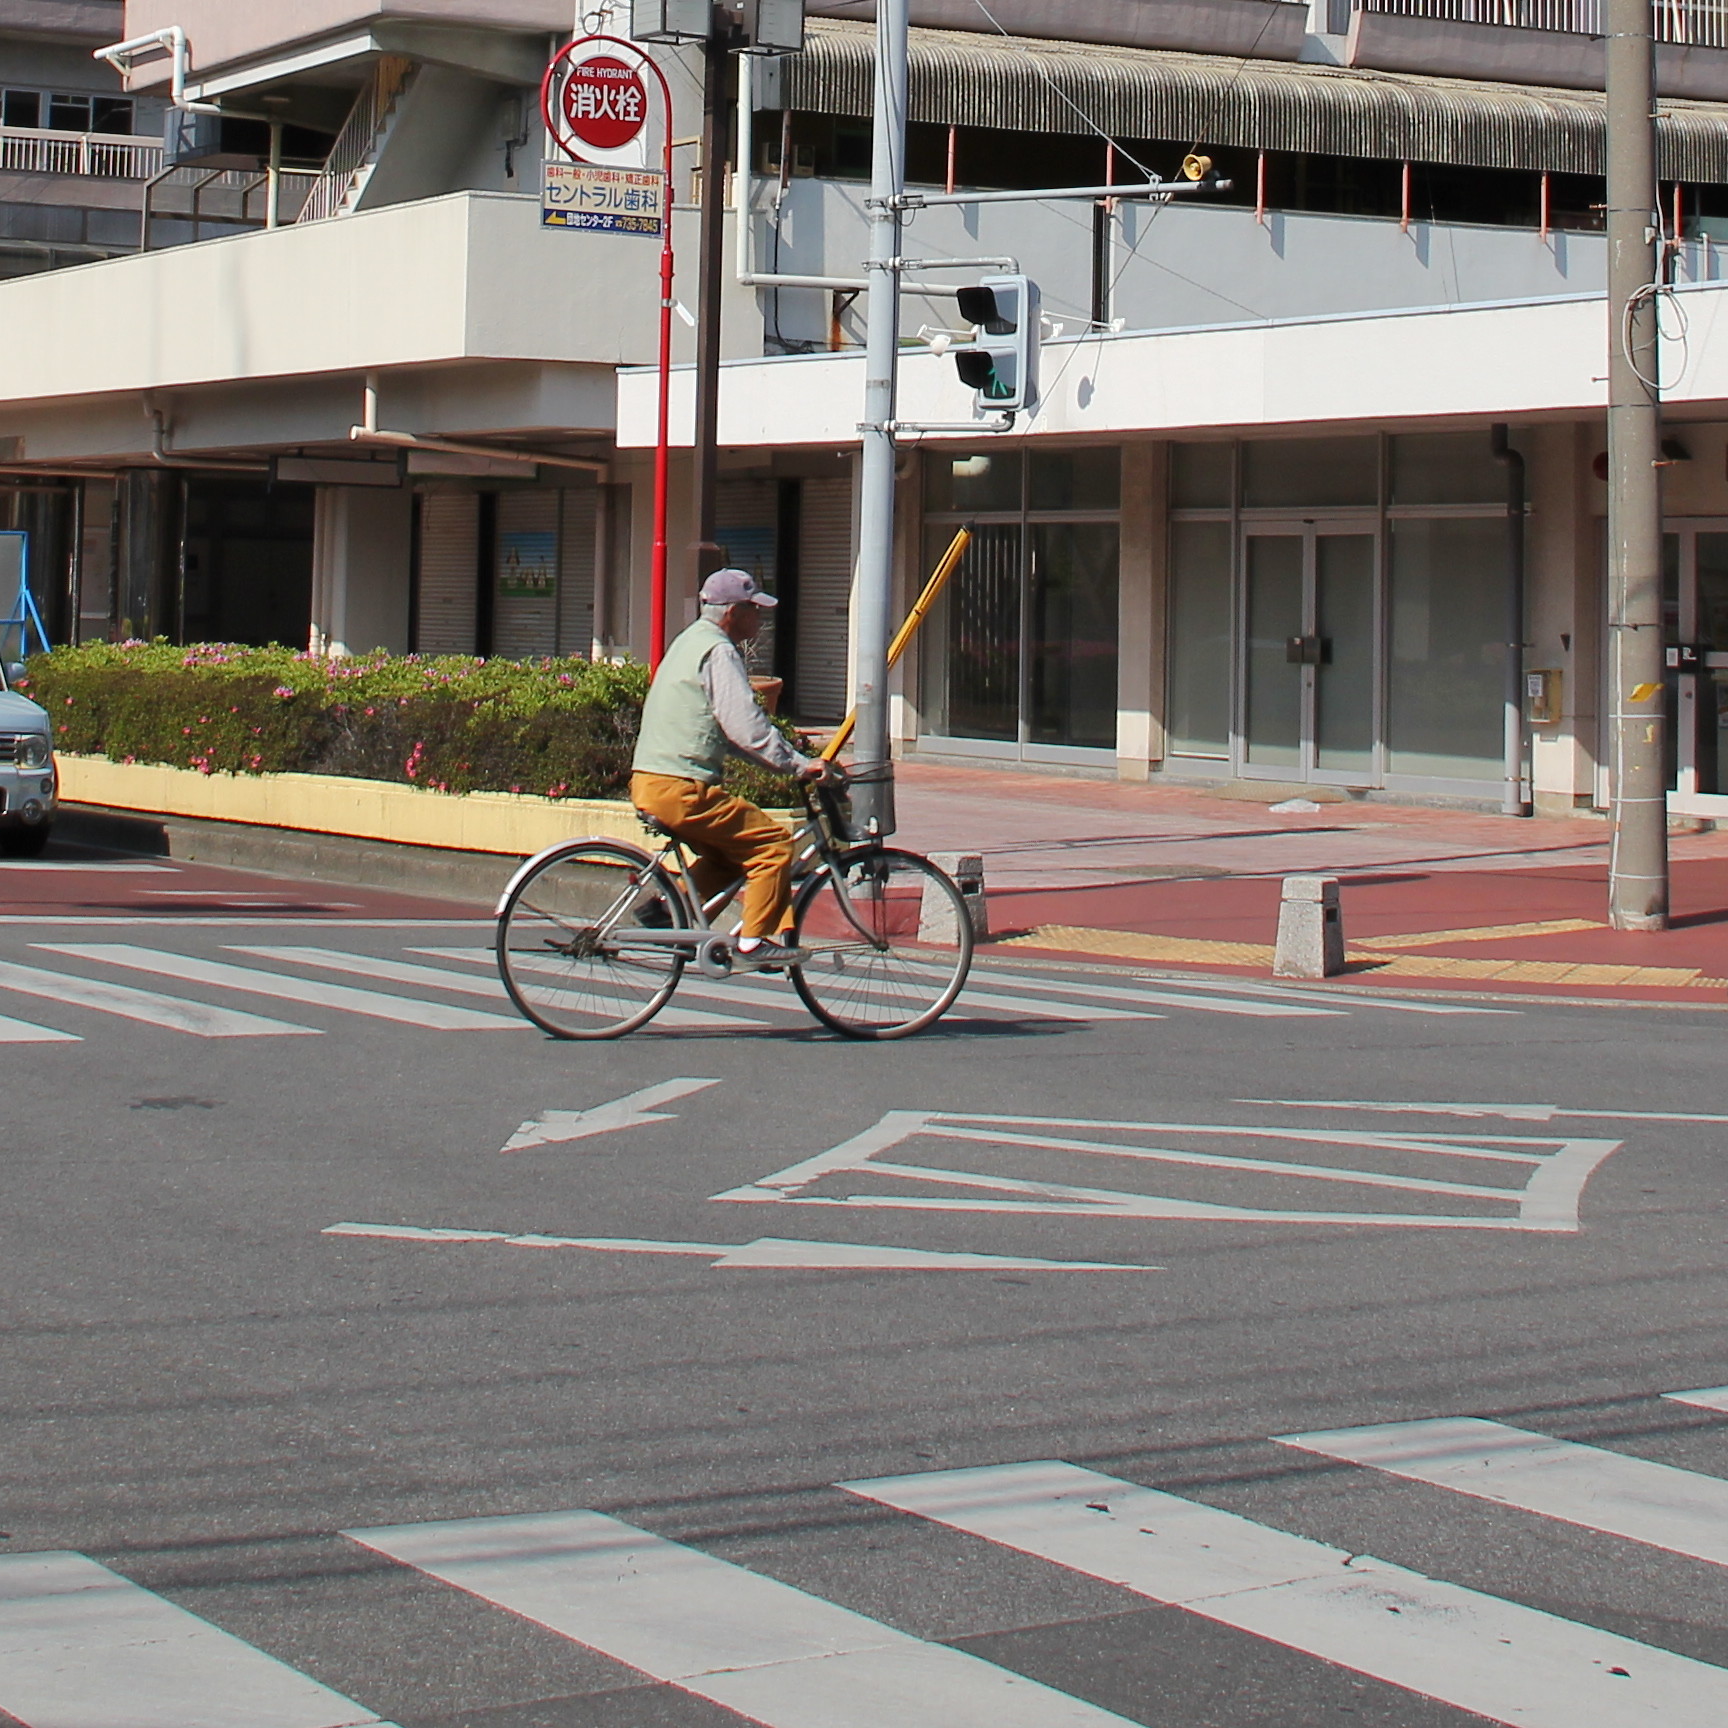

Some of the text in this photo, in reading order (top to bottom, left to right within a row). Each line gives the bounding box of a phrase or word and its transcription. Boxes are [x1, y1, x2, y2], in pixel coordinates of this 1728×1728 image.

[576, 66, 633, 80] FIRE HYDRANT
[570, 83, 642, 122] 消火栓
[546, 182, 658, 213] セントラル歯科
